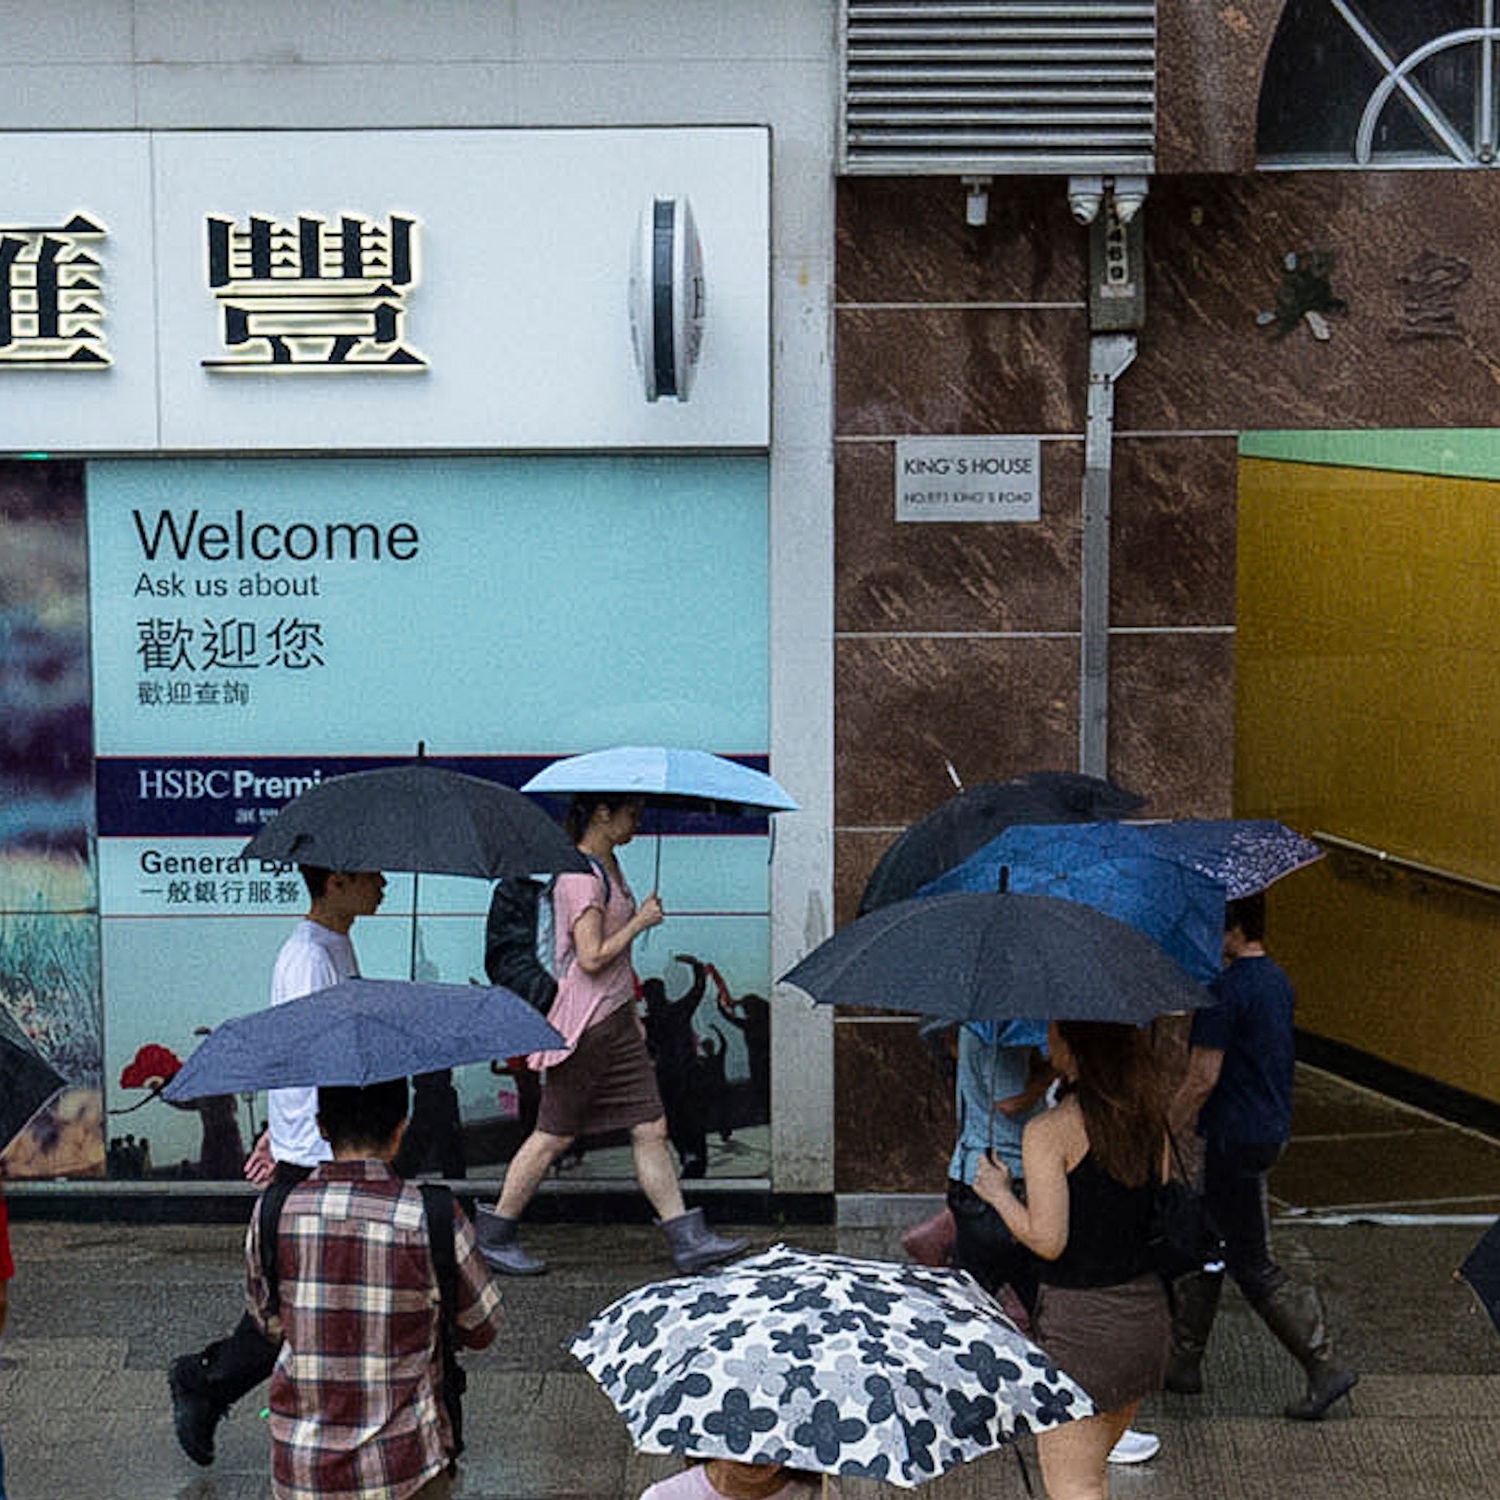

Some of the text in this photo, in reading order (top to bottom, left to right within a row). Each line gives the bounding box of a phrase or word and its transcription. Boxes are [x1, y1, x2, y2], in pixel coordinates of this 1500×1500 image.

[972, 458, 1032, 475] HOUSE
[133, 509, 420, 561] Welcome
[134, 573, 320, 598] Ask us about
[136, 616, 326, 672] 歡迎您
[137, 681, 250, 706] 歡迎查詢
[138, 769, 322, 799] HSBC Premi
[140, 850, 250, 875] General
[139, 880, 301, 904] 一般銀行服務
